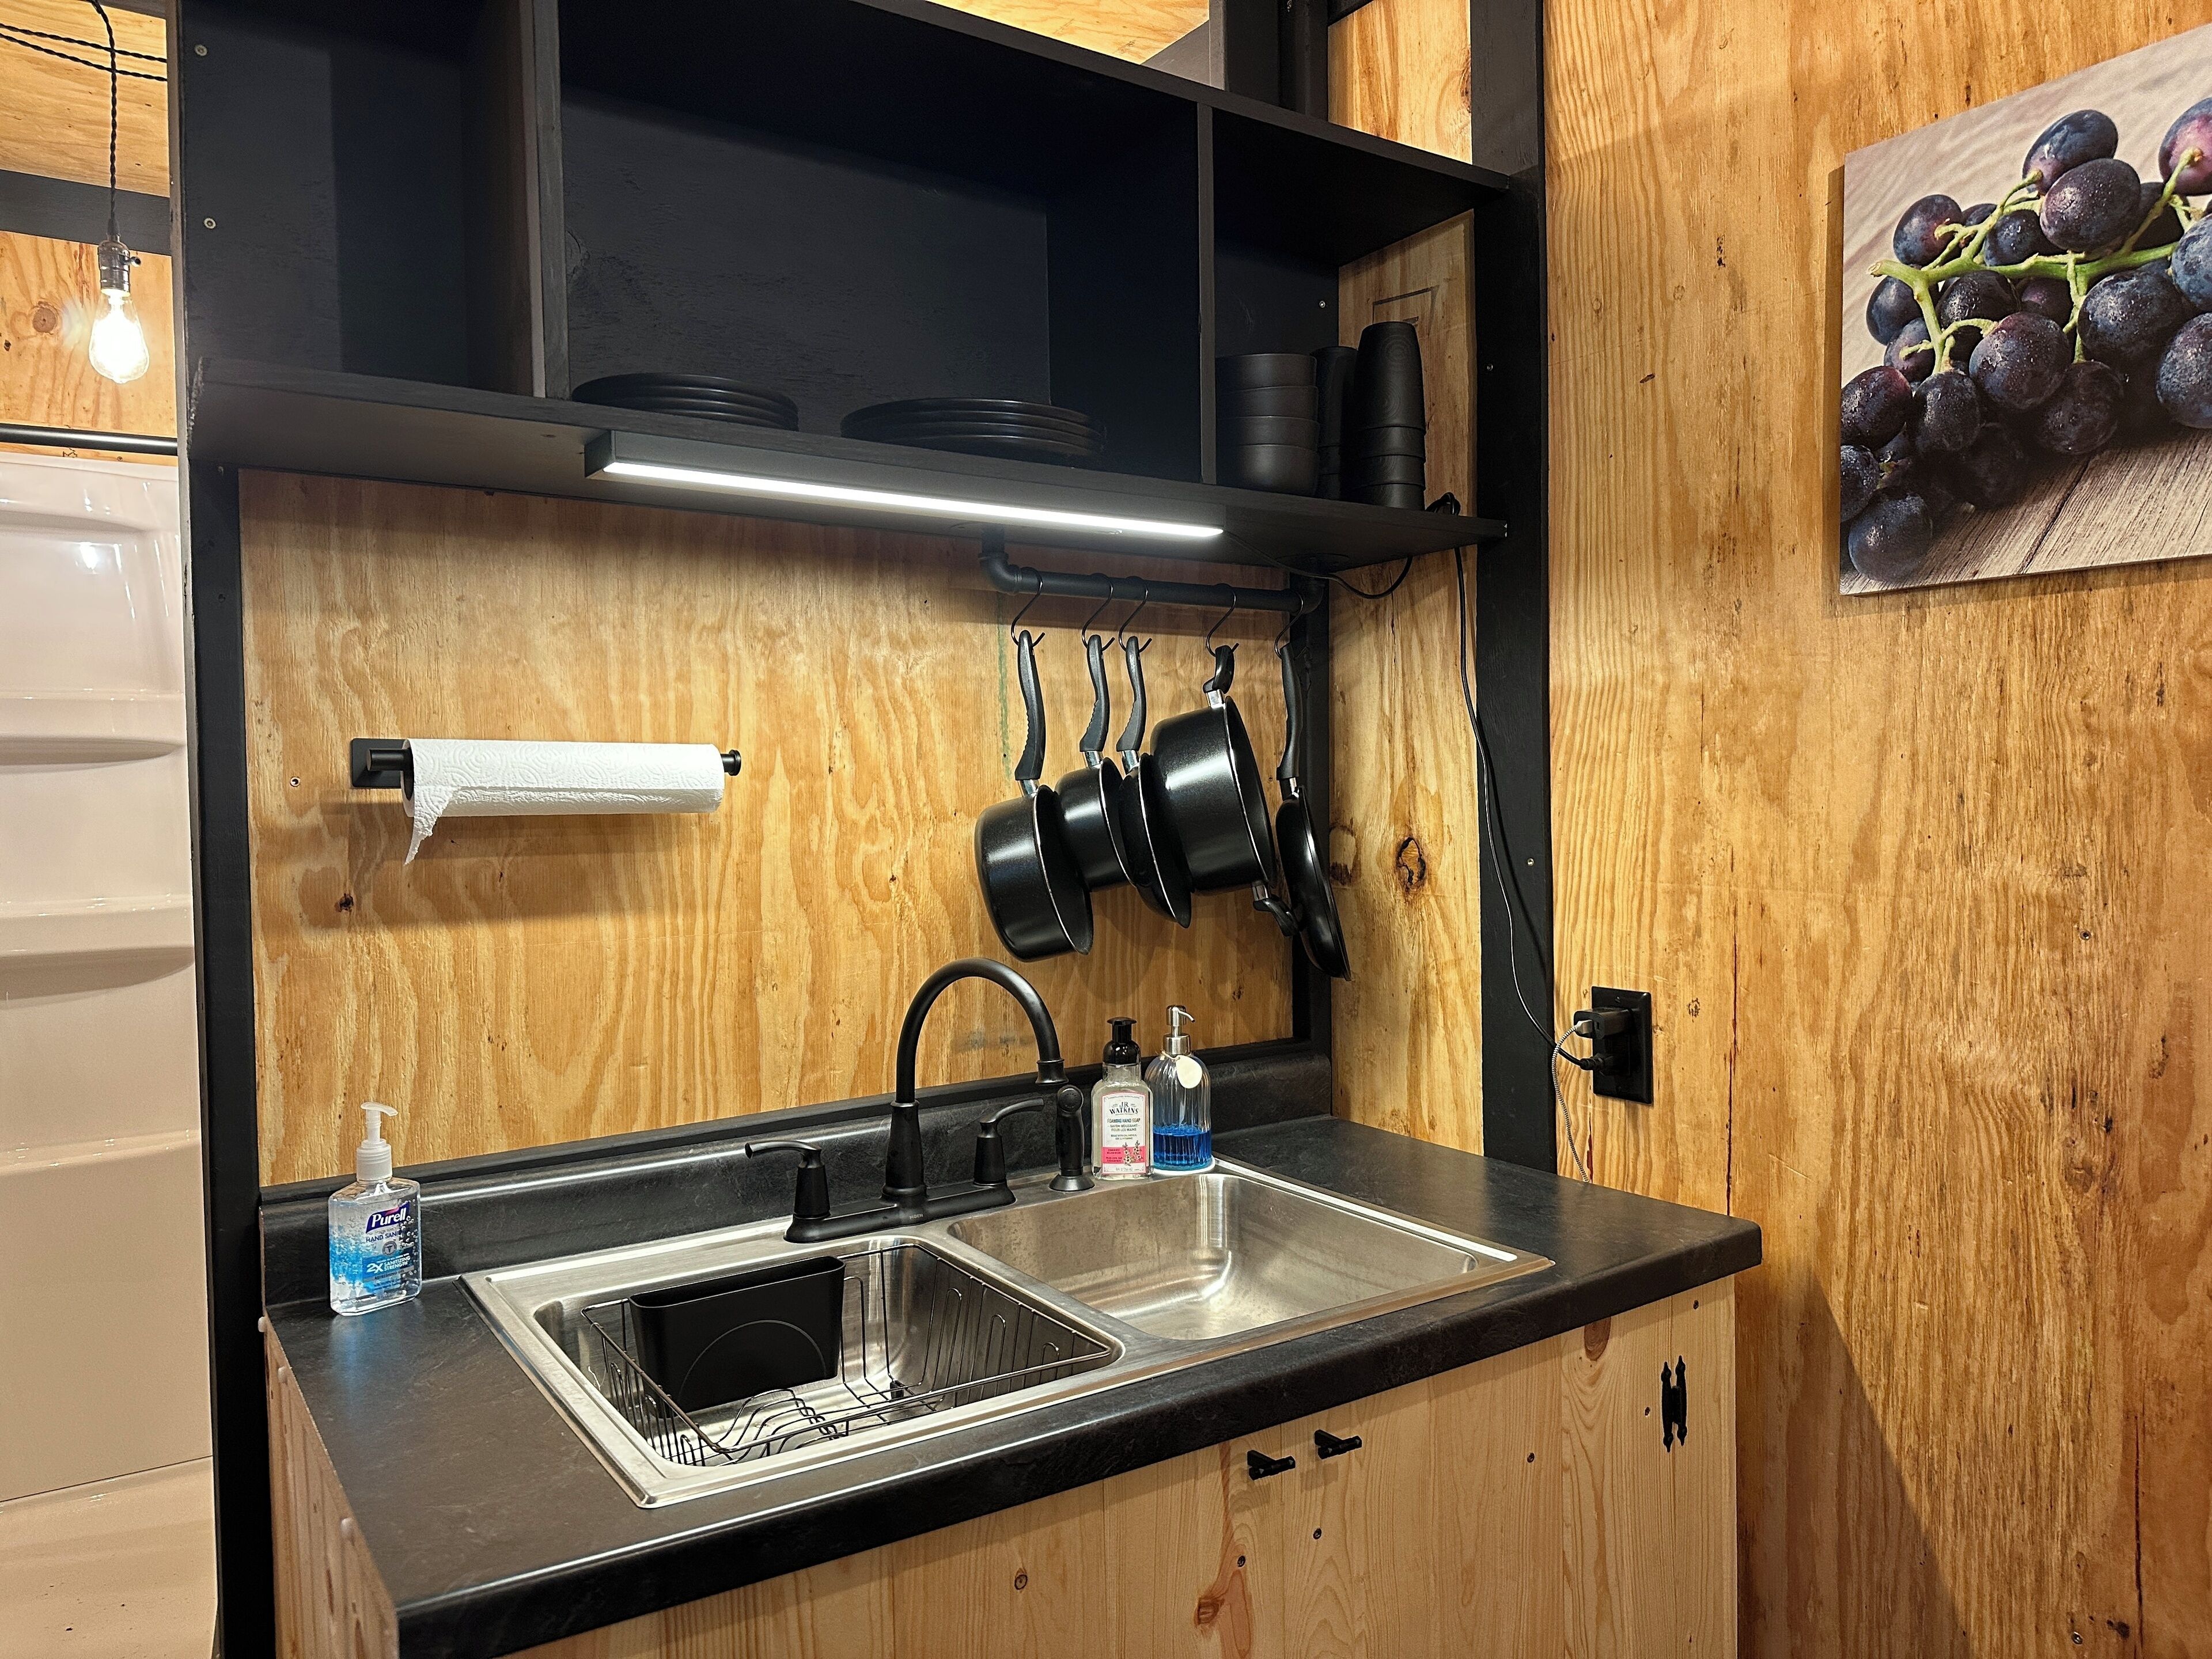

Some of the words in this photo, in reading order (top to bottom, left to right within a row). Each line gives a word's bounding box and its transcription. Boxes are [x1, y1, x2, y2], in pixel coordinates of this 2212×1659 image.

[372, 1207, 407, 1228] Purell
[366, 1234, 384, 1243] HAND
[384, 1255, 411, 1267] SANITIZING
[384, 1260, 408, 1271] STRENGTH
[366, 1263, 384, 1274] 2X
